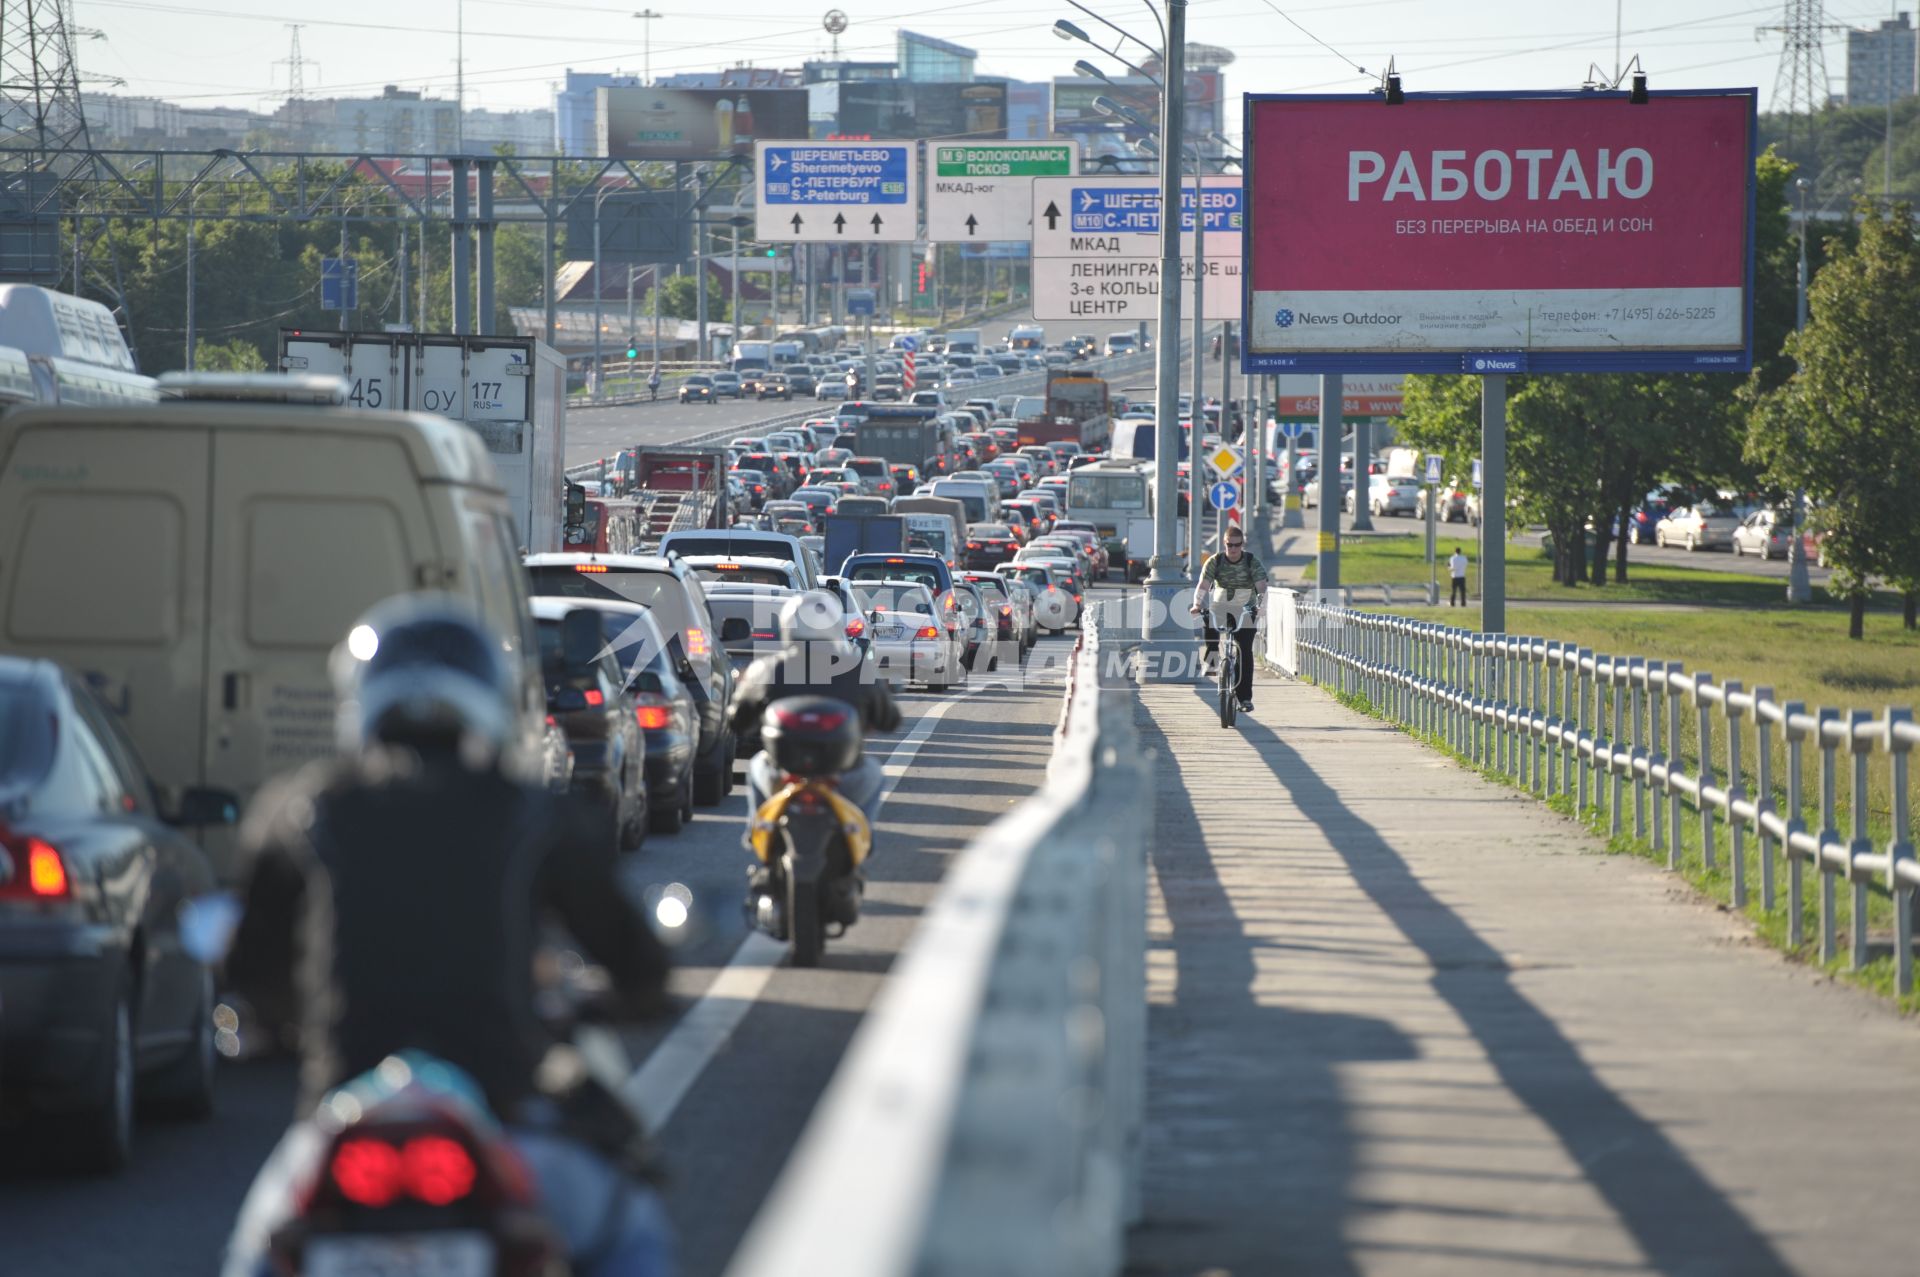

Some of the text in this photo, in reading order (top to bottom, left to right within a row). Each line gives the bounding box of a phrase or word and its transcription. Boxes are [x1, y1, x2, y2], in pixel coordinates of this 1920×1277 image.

[791, 151, 889, 161] ШЕРЕМЕТЬЕВО
[967, 150, 1066, 161] ВОЛОКОЛАМСК
[791, 163, 882, 175] Sheremetyevo
[967, 163, 1010, 174] ПСКОВ
[1348, 148, 1653, 200] РАБОТАЮ
[791, 177, 881, 188] С.-ПЕТЕРБУРГ
[936, 183, 994, 193] МКАД-юг
[791, 190, 869, 202] S.-Peterburg
[1104, 193, 1236, 208] ШЕРЕТЬЕВО
[1104, 213, 1225, 227] С.-ПЕТБРГ
[1396, 218, 1653, 235] БЕЗ ПЕРЕРЫВА НА ОБЕД И СОН
[1071, 237, 1120, 252] МКАД
[1071, 282, 1159, 295] 3-е КОЛЬЦ
[1070, 301, 1128, 315] ЦЕНТР
[1604, 308, 1619, 320] +7
[1657, 307, 1716, 320] 626-5225
[1298, 312, 1402, 325] News Outdoor
[1487, 360, 1516, 369] News
[472, 382, 502, 399] 177
[473, 401, 491, 409] RUS
